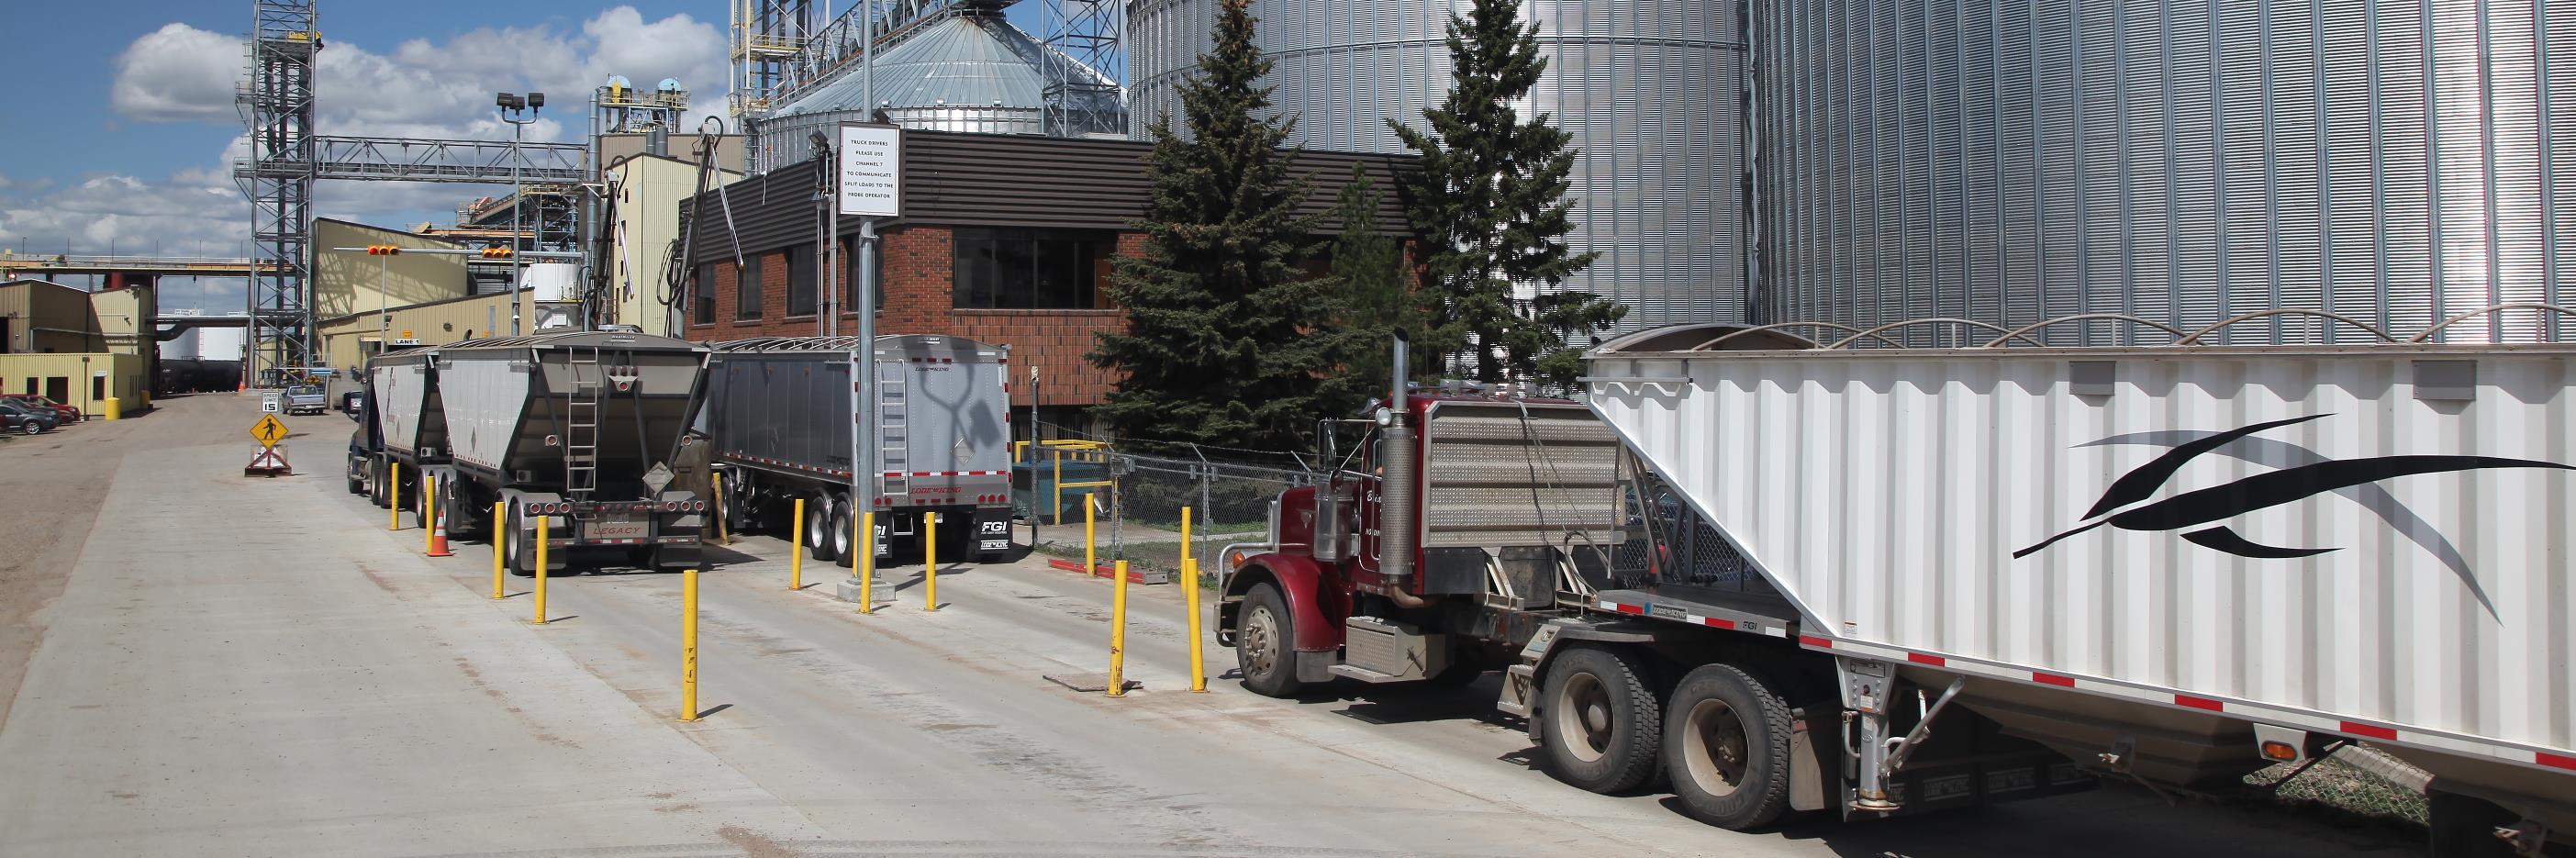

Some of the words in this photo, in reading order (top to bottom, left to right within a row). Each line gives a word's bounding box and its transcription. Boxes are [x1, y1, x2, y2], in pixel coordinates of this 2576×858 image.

[264, 403, 276, 411] 15
[982, 520, 1008, 532] FGI
[594, 527, 641, 535] LEGACY
[1743, 621, 1757, 630] FGI
